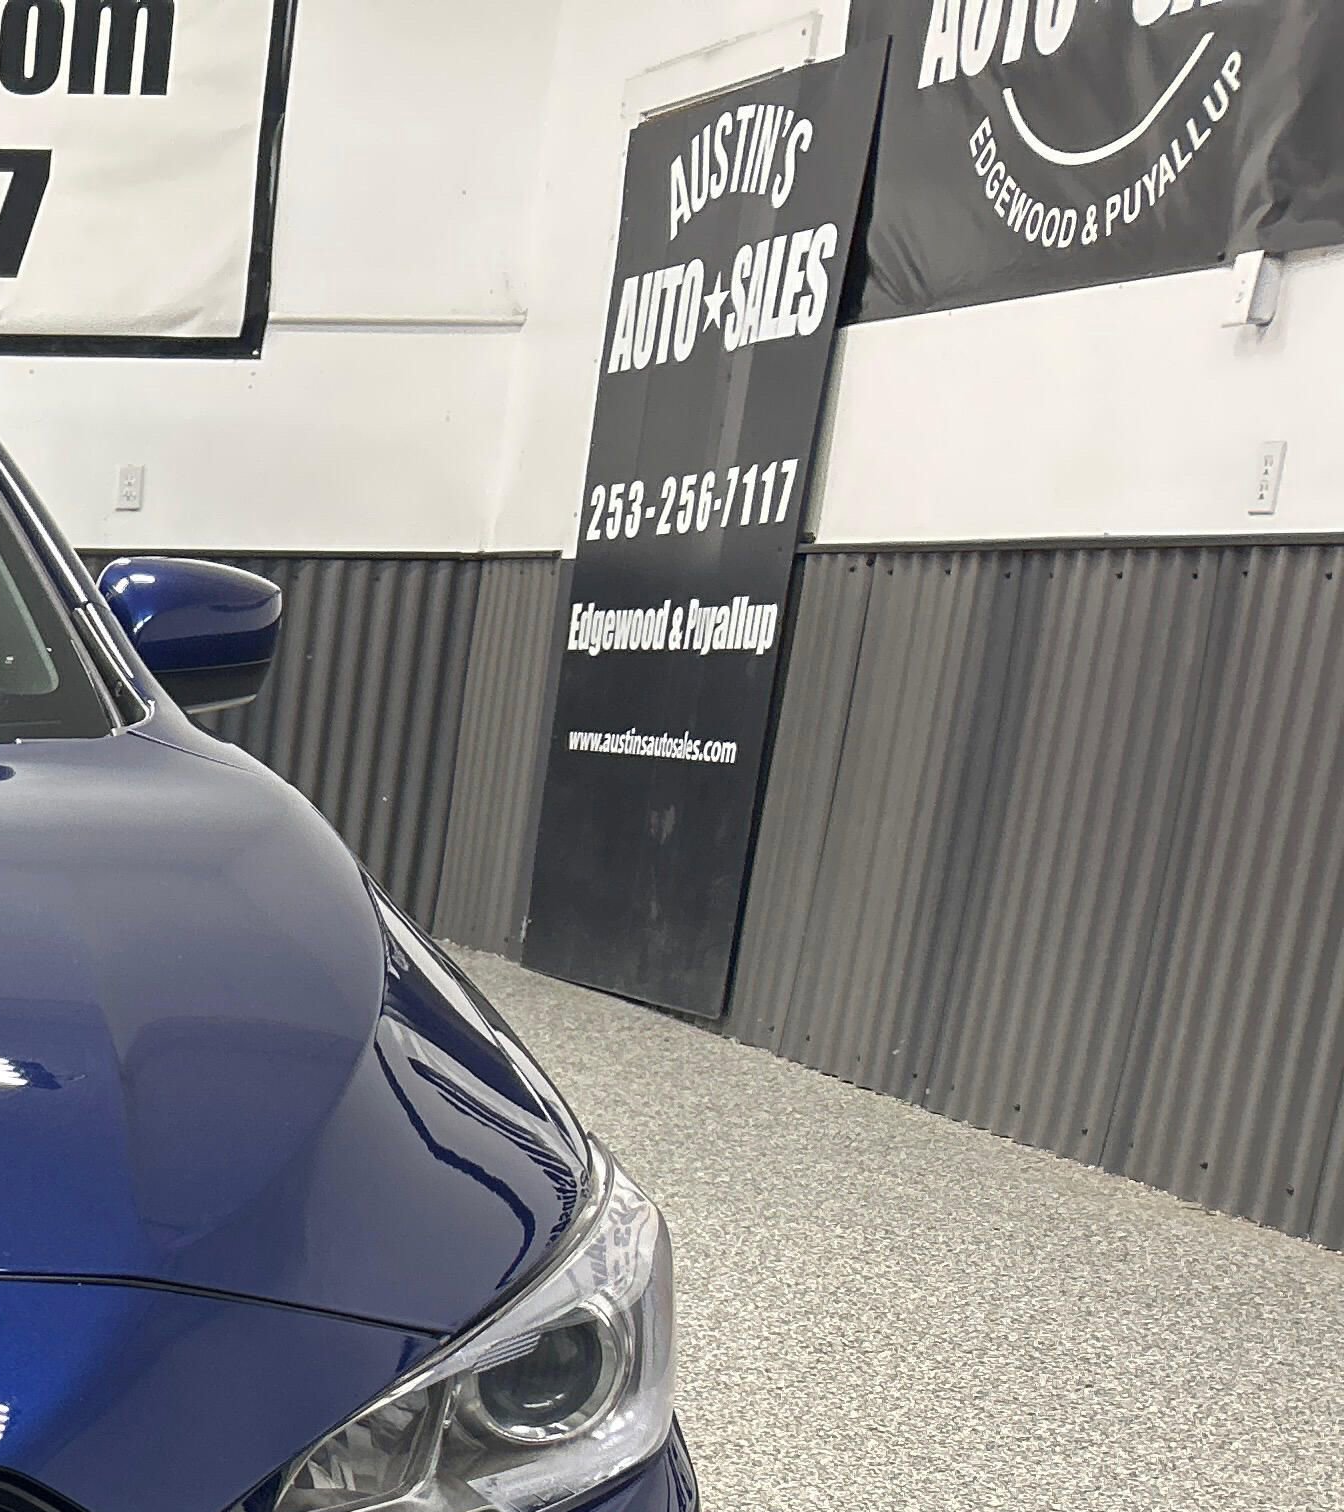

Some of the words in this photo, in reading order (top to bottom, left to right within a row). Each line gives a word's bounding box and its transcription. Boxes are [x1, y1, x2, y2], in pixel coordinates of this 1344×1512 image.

[669, 104, 813, 241] AUSTIN'S
[969, 116, 1077, 249] EDGEWOOD
[1081, 204, 1098, 246] &
[1105, 50, 1242, 237] PUYALLUP
[607, 258, 705, 374] AUTO
[723, 222, 838, 353] SALES
[585, 458, 799, 541] 253-256-7117
[567, 599, 671, 657] Edgewood
[668, 606, 684, 651] &
[683, 595, 778, 656] Puyallup
[568, 727, 737, 764] www.austinsautosales.com
